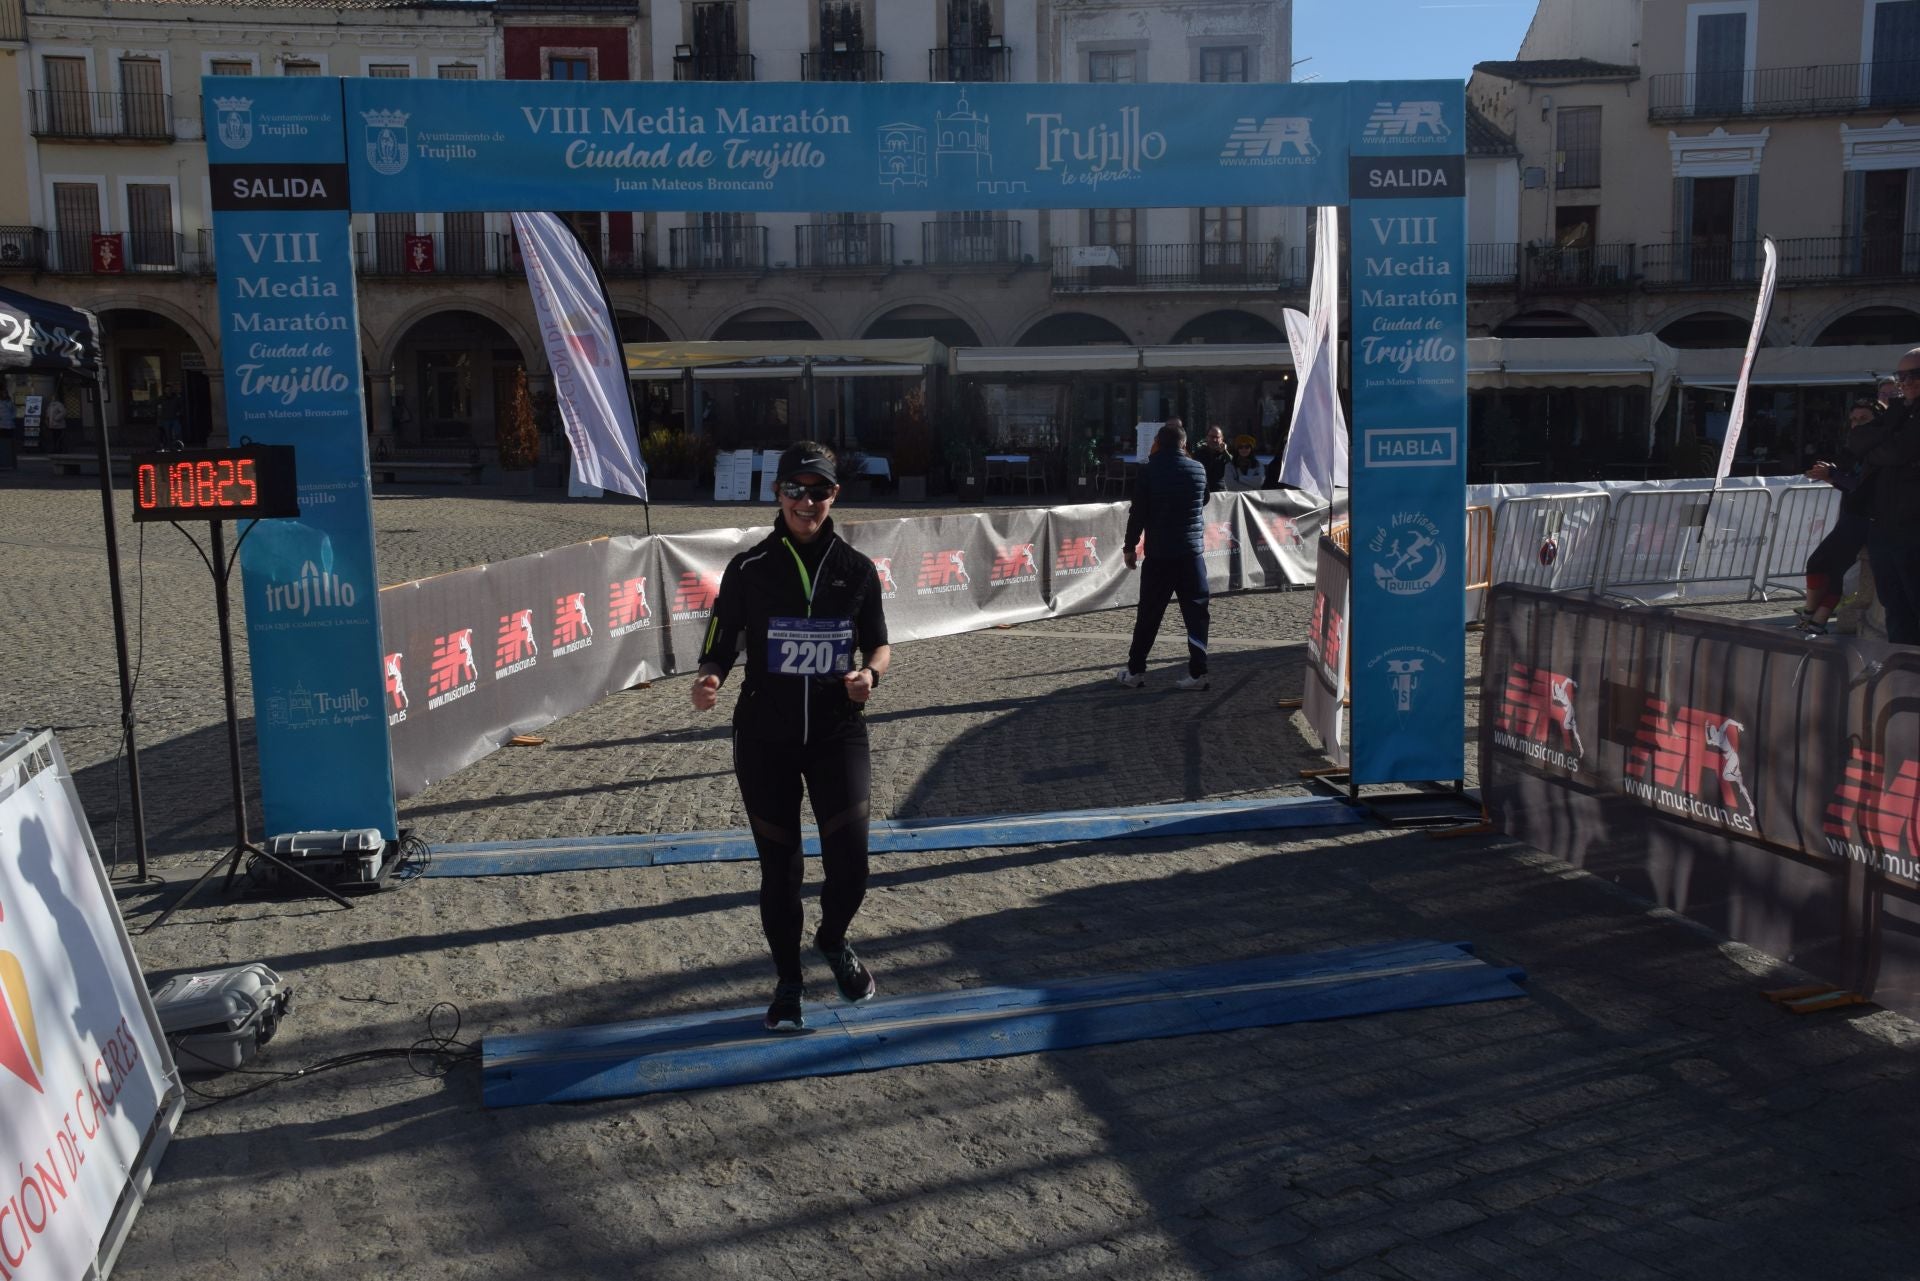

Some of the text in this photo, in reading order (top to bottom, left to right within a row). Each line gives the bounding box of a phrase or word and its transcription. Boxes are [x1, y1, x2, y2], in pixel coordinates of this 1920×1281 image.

[257, 113, 332, 123] Ayuntamiento de
[520, 106, 851, 135] VIII Media Maratón
[257, 124, 308, 138] Trujillo
[417, 131, 505, 144] Ayuntamiento de
[1025, 105, 1167, 172] Trujillo
[1362, 135, 1448, 145] www.musicrun.es
[417, 144, 477, 162] Trujillo
[564, 138, 827, 180] Ciudad de Trujillo
[1219, 155, 1318, 167] www.musicrun.es
[613, 178, 774, 193] Juan Mateos Broncano
[1061, 164, 1078, 186] te
[1368, 168, 1448, 188] SALIDA
[233, 177, 327, 199] SALIDA
[1369, 216, 1439, 246] VIII
[238, 232, 322, 264] VIII
[1364, 256, 1452, 277] Media
[235, 276, 339, 298] Media
[1360, 288, 1459, 308] Maratón
[232, 311, 350, 332] Maratón
[1372, 316, 1443, 332] Ciudad de
[249, 342, 333, 359] Ciudad de
[1360, 336, 1456, 374] Trujillo
[235, 363, 349, 405] Trujillo
[1366, 379, 1385, 388] Juan
[1386, 378, 1416, 387] Mateos
[244, 408, 349, 420] Juan Mateos Broncano
[1378, 439, 1444, 457] HABLA
[137, 458, 259, 510] 01:08:25
[297, 492, 336, 507] rujillo
[1368, 511, 1440, 553] Club Atletismo
[265, 560, 355, 617] trujillo
[917, 584, 968, 595] www.musicrun.es
[990, 574, 1036, 587] www.musicrun.es
[610, 617, 650, 638] www.musicrun.es
[552, 636, 593, 658] www.musicrun.es
[780, 640, 834, 674] 220
[496, 656, 536, 680] www.musicrun.es
[313, 687, 369, 714] Trujillo
[428, 681, 476, 711] www.musicrun.es
[1494, 729, 1579, 773] www.musicrun.es
[1625, 776, 1754, 832] www.musicrun.es
[57, 1112, 86, 1184] DE
[76, 1017, 140, 1140] CÁCERES
